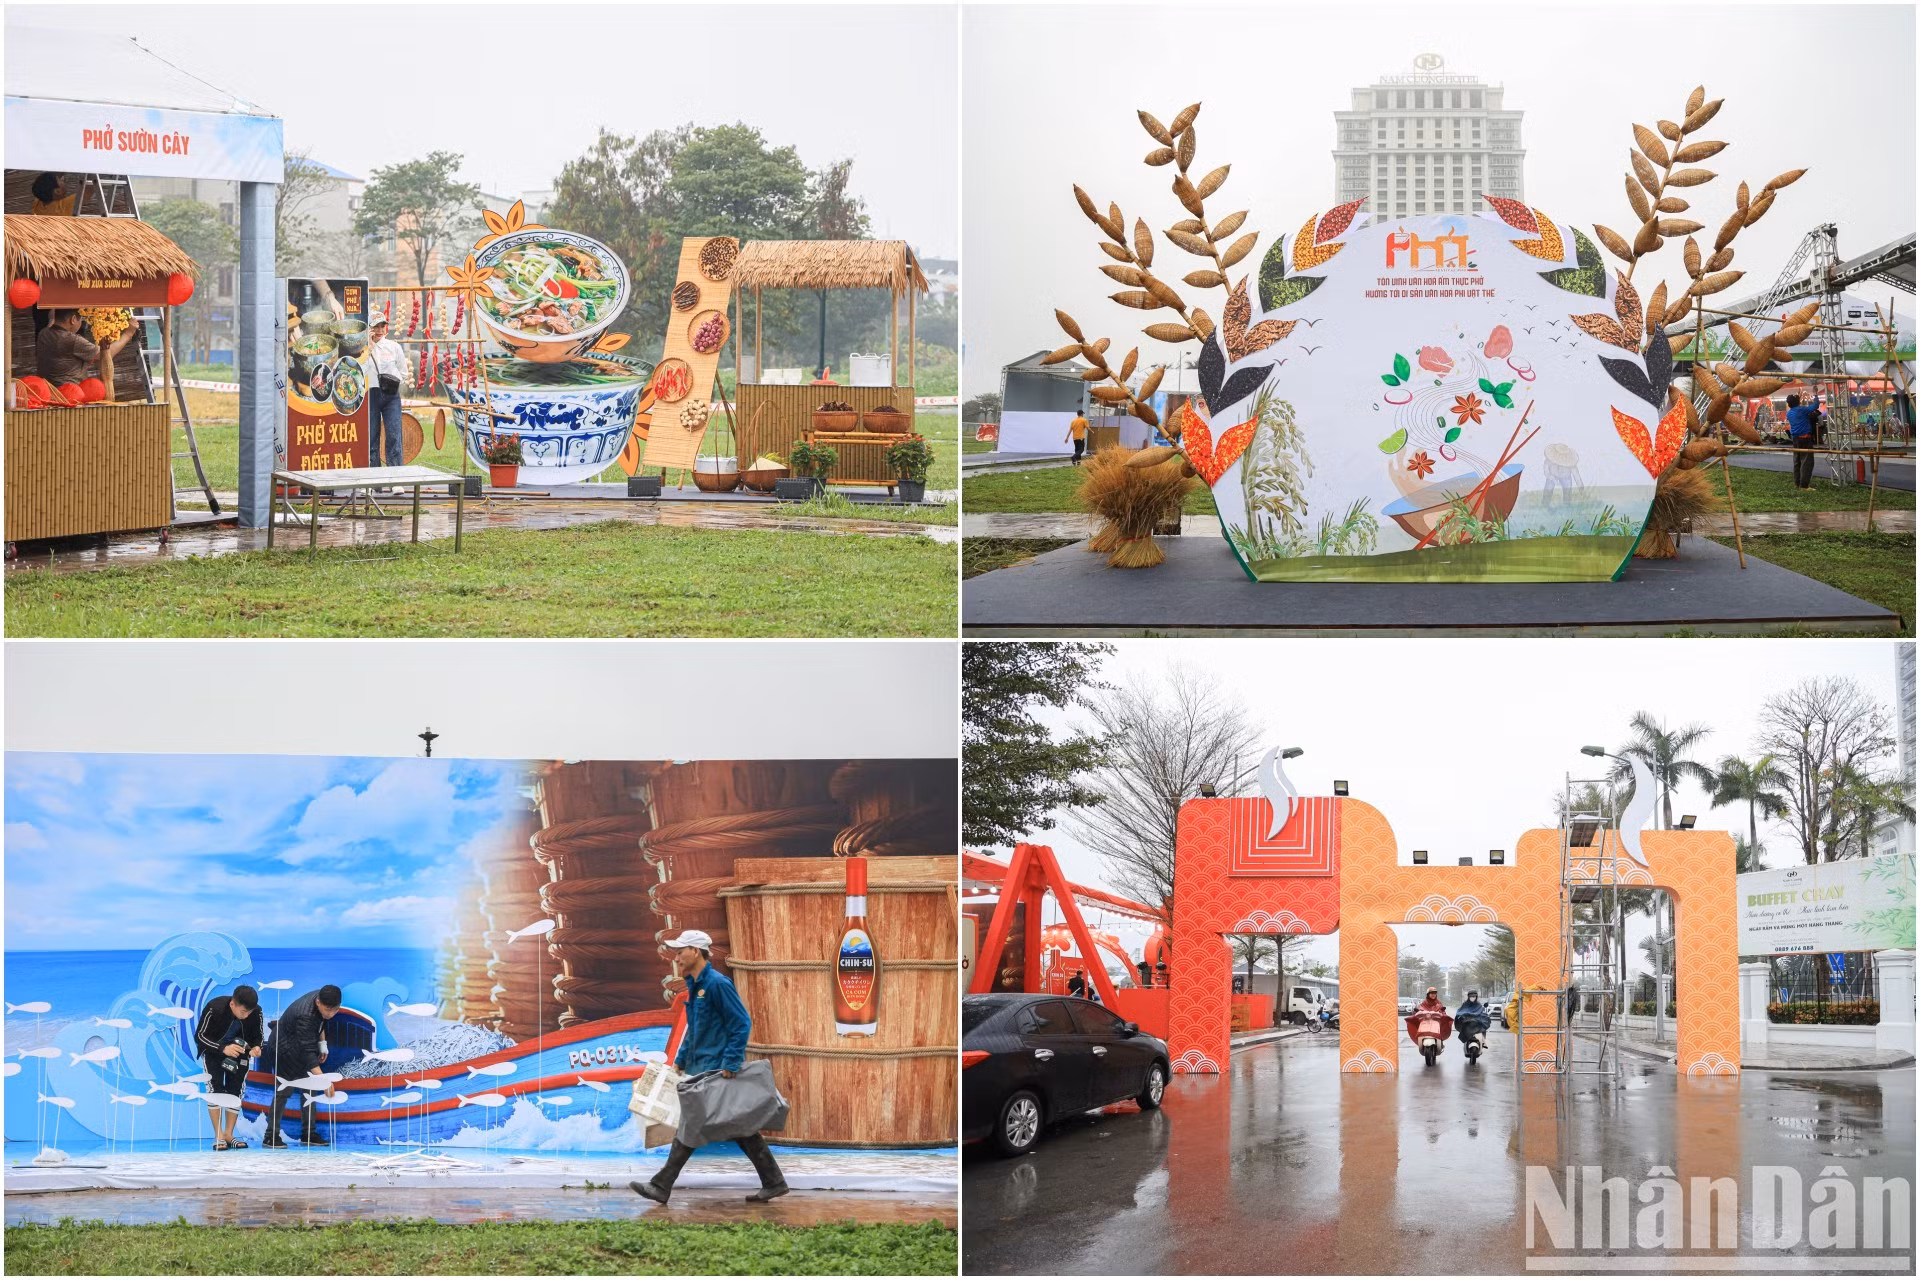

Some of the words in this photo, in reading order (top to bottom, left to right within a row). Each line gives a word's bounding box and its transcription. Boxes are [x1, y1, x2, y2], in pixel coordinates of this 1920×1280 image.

[1446, 75, 1479, 84] HOTEL
[82, 123, 114, 151] PHỞ
[117, 128, 158, 154] SƯỜN
[162, 131, 190, 156] CÂY
[1470, 275, 1485, 286] PHỞ
[1454, 289, 1466, 298] PHI
[296, 418, 326, 446] PHỞ
[328, 420, 358, 444] XƯA
[300, 447, 330, 472] ĐỐT
[333, 447, 354, 470] ĐÁ
[1747, 891, 1797, 907] BUFFET
[1802, 884, 1845, 902] CHAY
[839, 958, 873, 967] CHIN-SU
